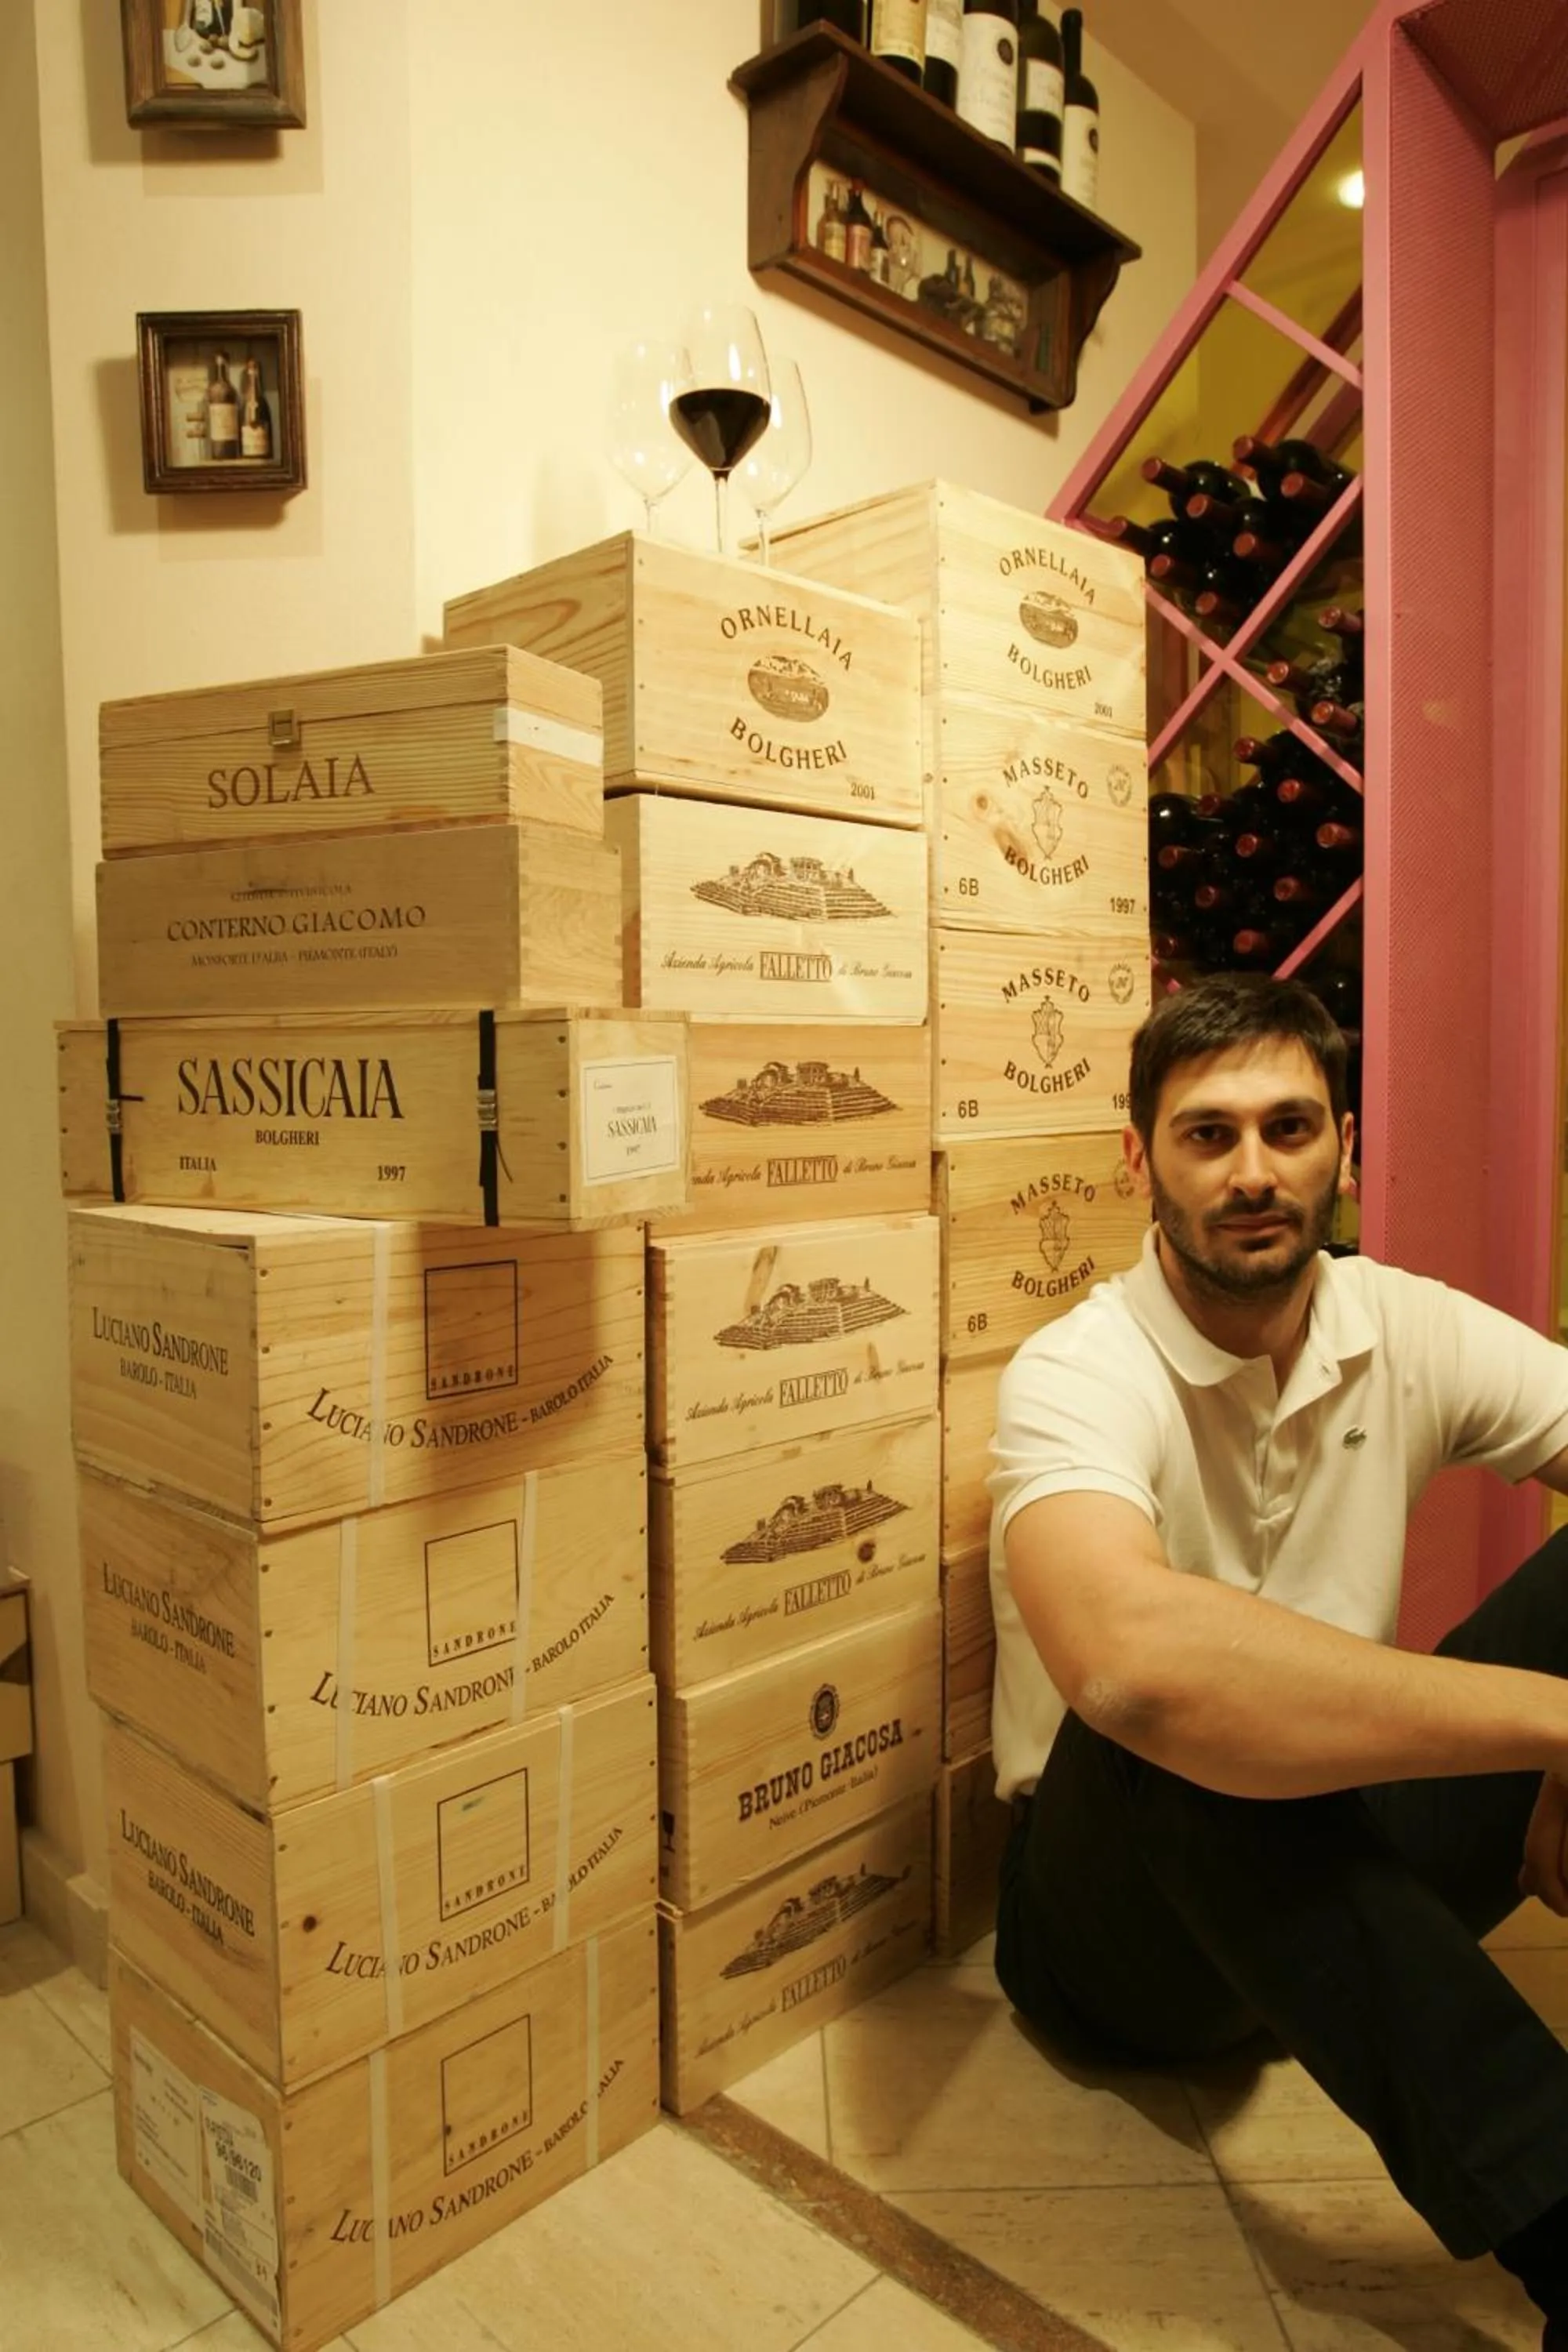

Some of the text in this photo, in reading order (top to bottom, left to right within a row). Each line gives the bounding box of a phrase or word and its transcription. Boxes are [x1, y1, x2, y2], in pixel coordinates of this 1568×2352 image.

[999, 546, 1095, 605] ORNELLAIA
[720, 604, 853, 671] ORNELLAIA
[1007, 643, 1092, 690] BOLGHERI
[730, 717, 848, 769] BOLGHERI
[207, 753, 375, 809] SOLAIA
[851, 782, 876, 800] 2001
[1002, 757, 1089, 799] MASSETO
[959, 877, 979, 896] 6B
[1004, 846, 1090, 886] BOLGHERI
[166, 905, 426, 942] CONTERNO GIACOMO
[1110, 897, 1136, 914] 1997
[760, 953, 833, 981] FALLETTO
[1001, 967, 1091, 1004] MASSETO
[178, 1056, 405, 1119] SASSICAIA
[1004, 1057, 1091, 1094] BOLGHERI
[957, 1099, 979, 1119] 6B
[1112, 1093, 1131, 1110] 199
[256, 1129, 320, 1146] BOLGHERI
[180, 1156, 216, 1171] ITALIA
[377, 1165, 407, 1181] 1997
[768, 1156, 839, 1187] FALLETTO
[1010, 1173, 1096, 1215] MASSETO
[1011, 1254, 1095, 1298] BOLGHERI
[92, 1306, 229, 1376] LUCIANO SANDRONE
[967, 1312, 988, 1334] 6B
[430, 1364, 514, 1392] SANDRONE
[780, 1369, 848, 1407] FALLETTO
[411, 1410, 519, 1448] SANDRONE
[530, 1385, 578, 1424] BAROLO
[576, 1354, 614, 1393] ITALIA
[103, 1561, 235, 1658] LUCIANO SANDRONE
[784, 1570, 852, 1615] FALLETTO
[433, 1620, 517, 1657] SANDRONE
[532, 1626, 580, 1674] BAROLO
[579, 1593, 615, 1636] ITALIA
[738, 1719, 904, 1823] BRUNO GIACOSA
[121, 1809, 255, 1937] LUCIANO SANDRONE
[444, 1864, 528, 1911] SANDRONE
[426, 1906, 532, 1971] SANDRONE
[586, 1826, 623, 1871] ITALIA
[448, 2110, 529, 2166] SANDRONE
[330, 2208, 423, 2243] LUCNO
[429, 2149, 535, 2225] SANDRONE
